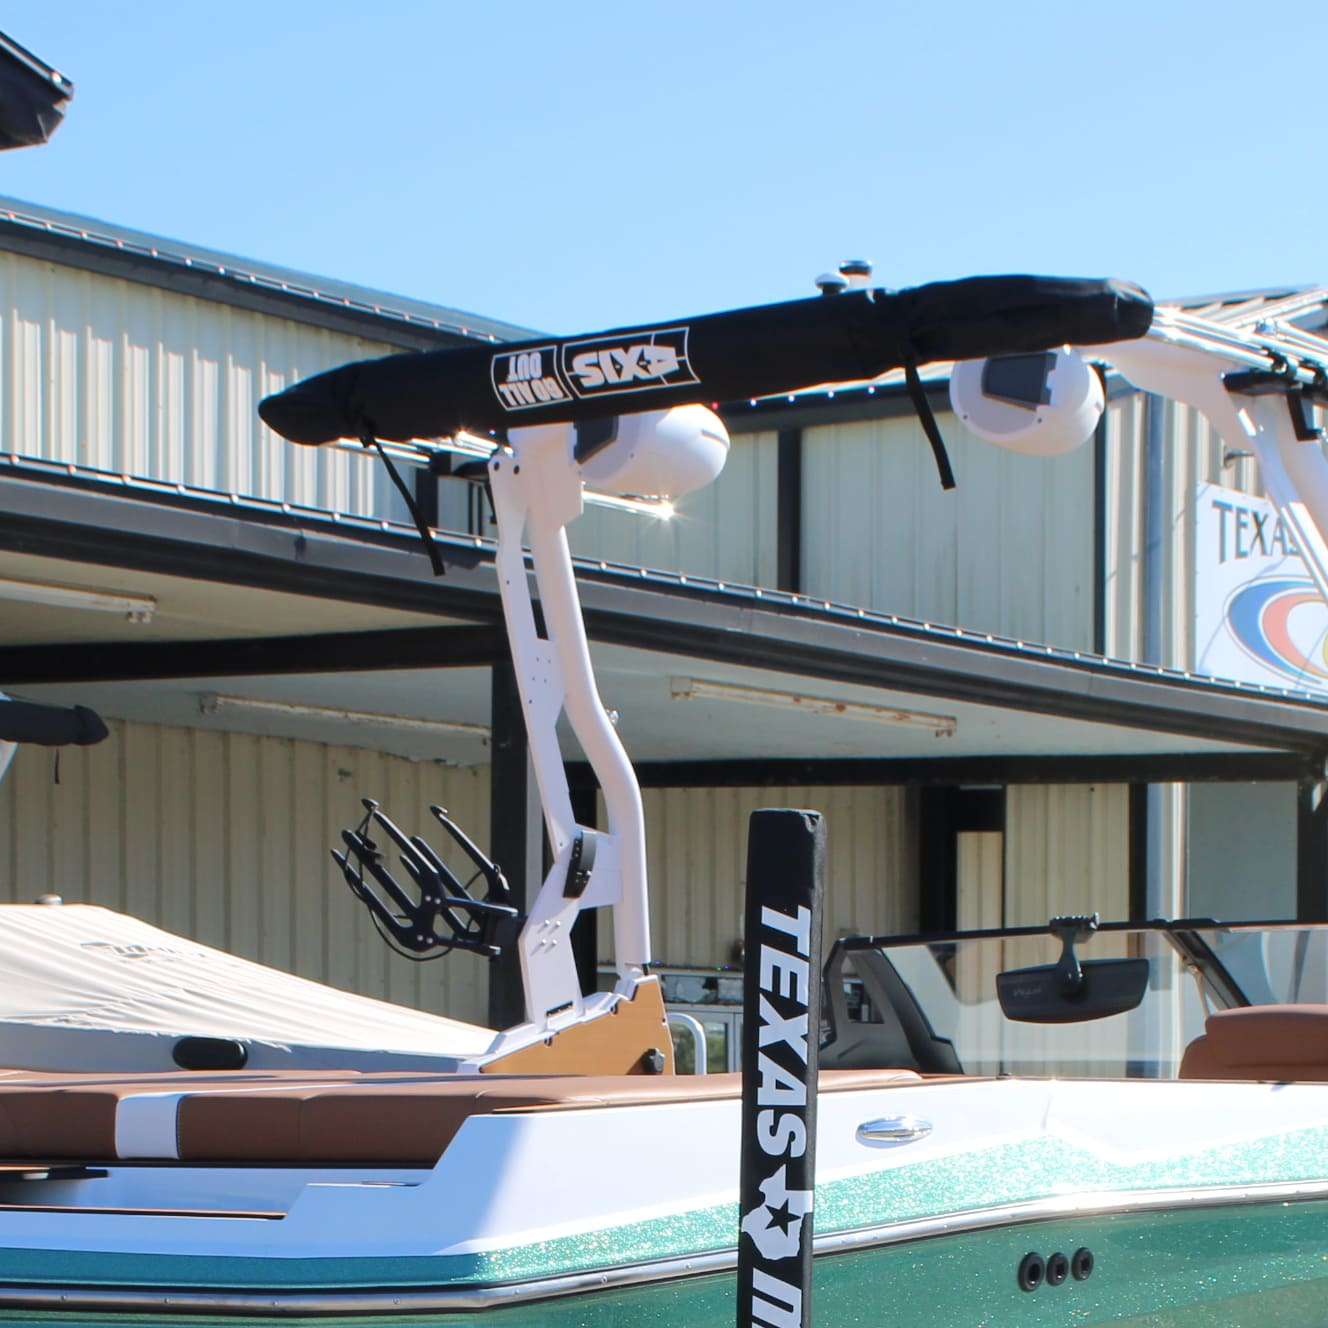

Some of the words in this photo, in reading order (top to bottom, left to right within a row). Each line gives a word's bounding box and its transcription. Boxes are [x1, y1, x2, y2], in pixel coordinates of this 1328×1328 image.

[506, 351, 542, 382] OUT
[573, 344, 680, 388] AXIS
[498, 381, 536, 407] ALL
[531, 376, 564, 402] GO
[756, 904, 811, 1159] TEXAS
